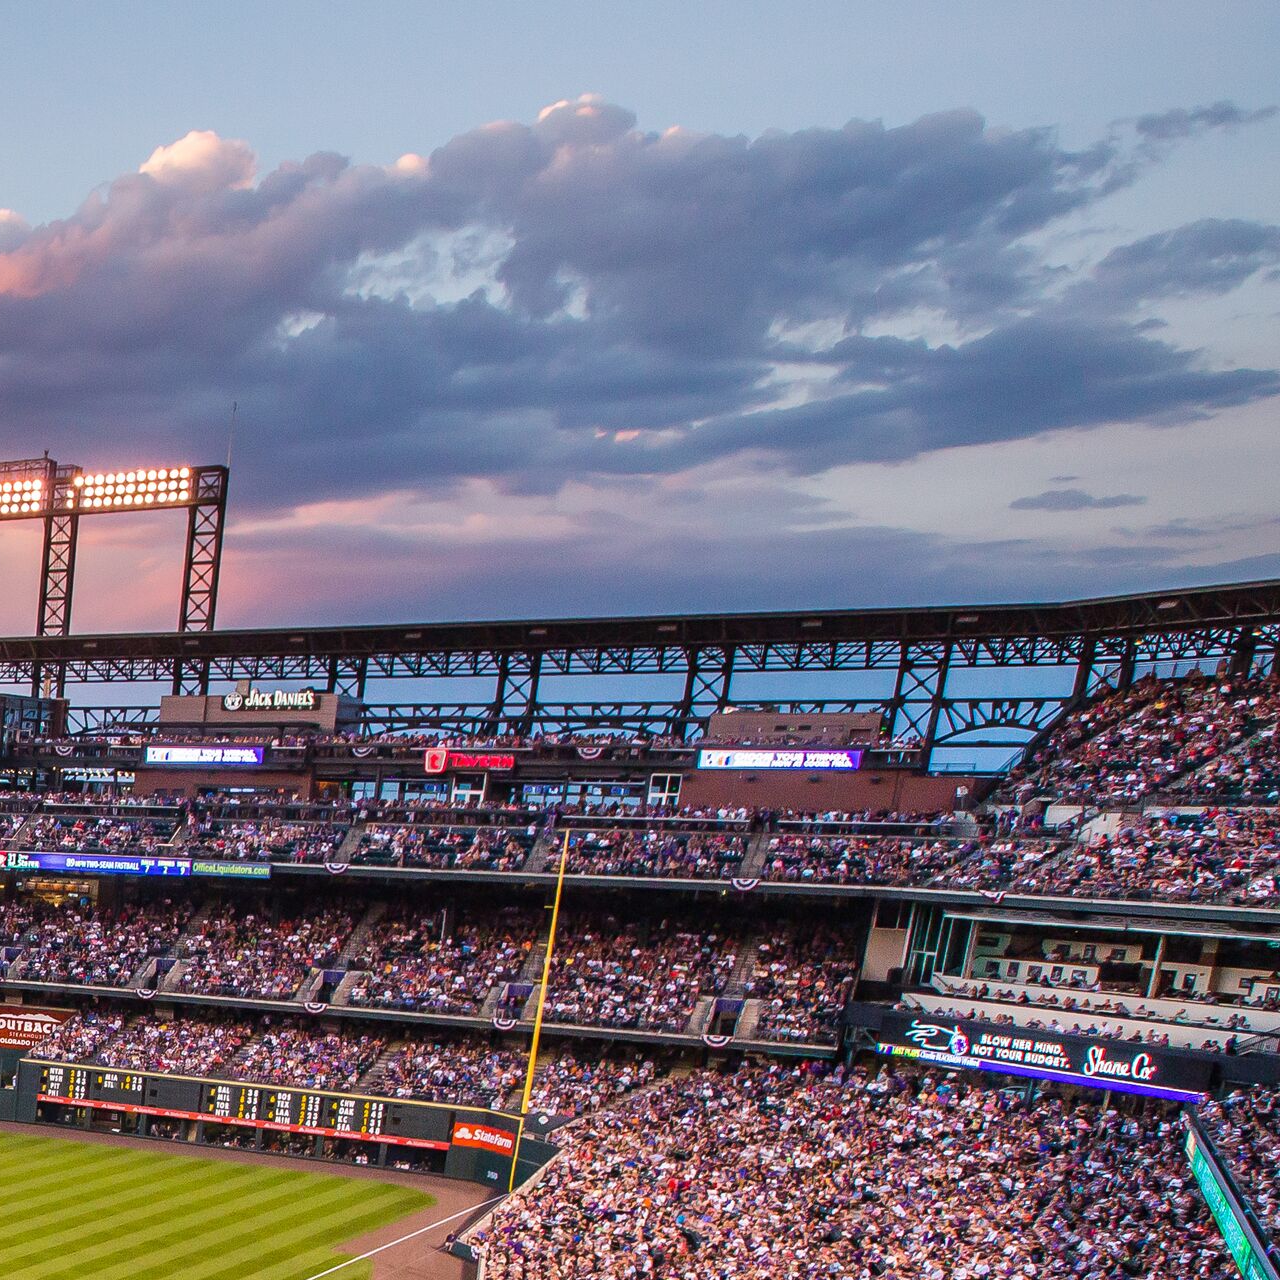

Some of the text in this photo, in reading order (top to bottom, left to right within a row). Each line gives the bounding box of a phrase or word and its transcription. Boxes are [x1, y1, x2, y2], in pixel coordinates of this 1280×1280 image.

[244, 688, 315, 706] JACK DANIEL'S
[448, 753, 515, 768] TAVERN
[66, 858, 140, 870] 89 TWO-SEAM FASTBALL
[192, 862, 270, 876] OfficeLiquidators.com
[980, 1034, 1065, 1056] BLOW HER MIND.
[971, 1045, 1071, 1069] NOT YOUR BUDGET.
[1083, 1046, 1129, 1077] Shane
[103, 1081, 114, 1089] STL
[216, 1101, 230, 1110] TOR
[277, 1100, 290, 1108] TEX
[275, 1108, 290, 1117] LAA
[338, 1107, 354, 1116] OAK
[338, 1115, 348, 1123] KC
